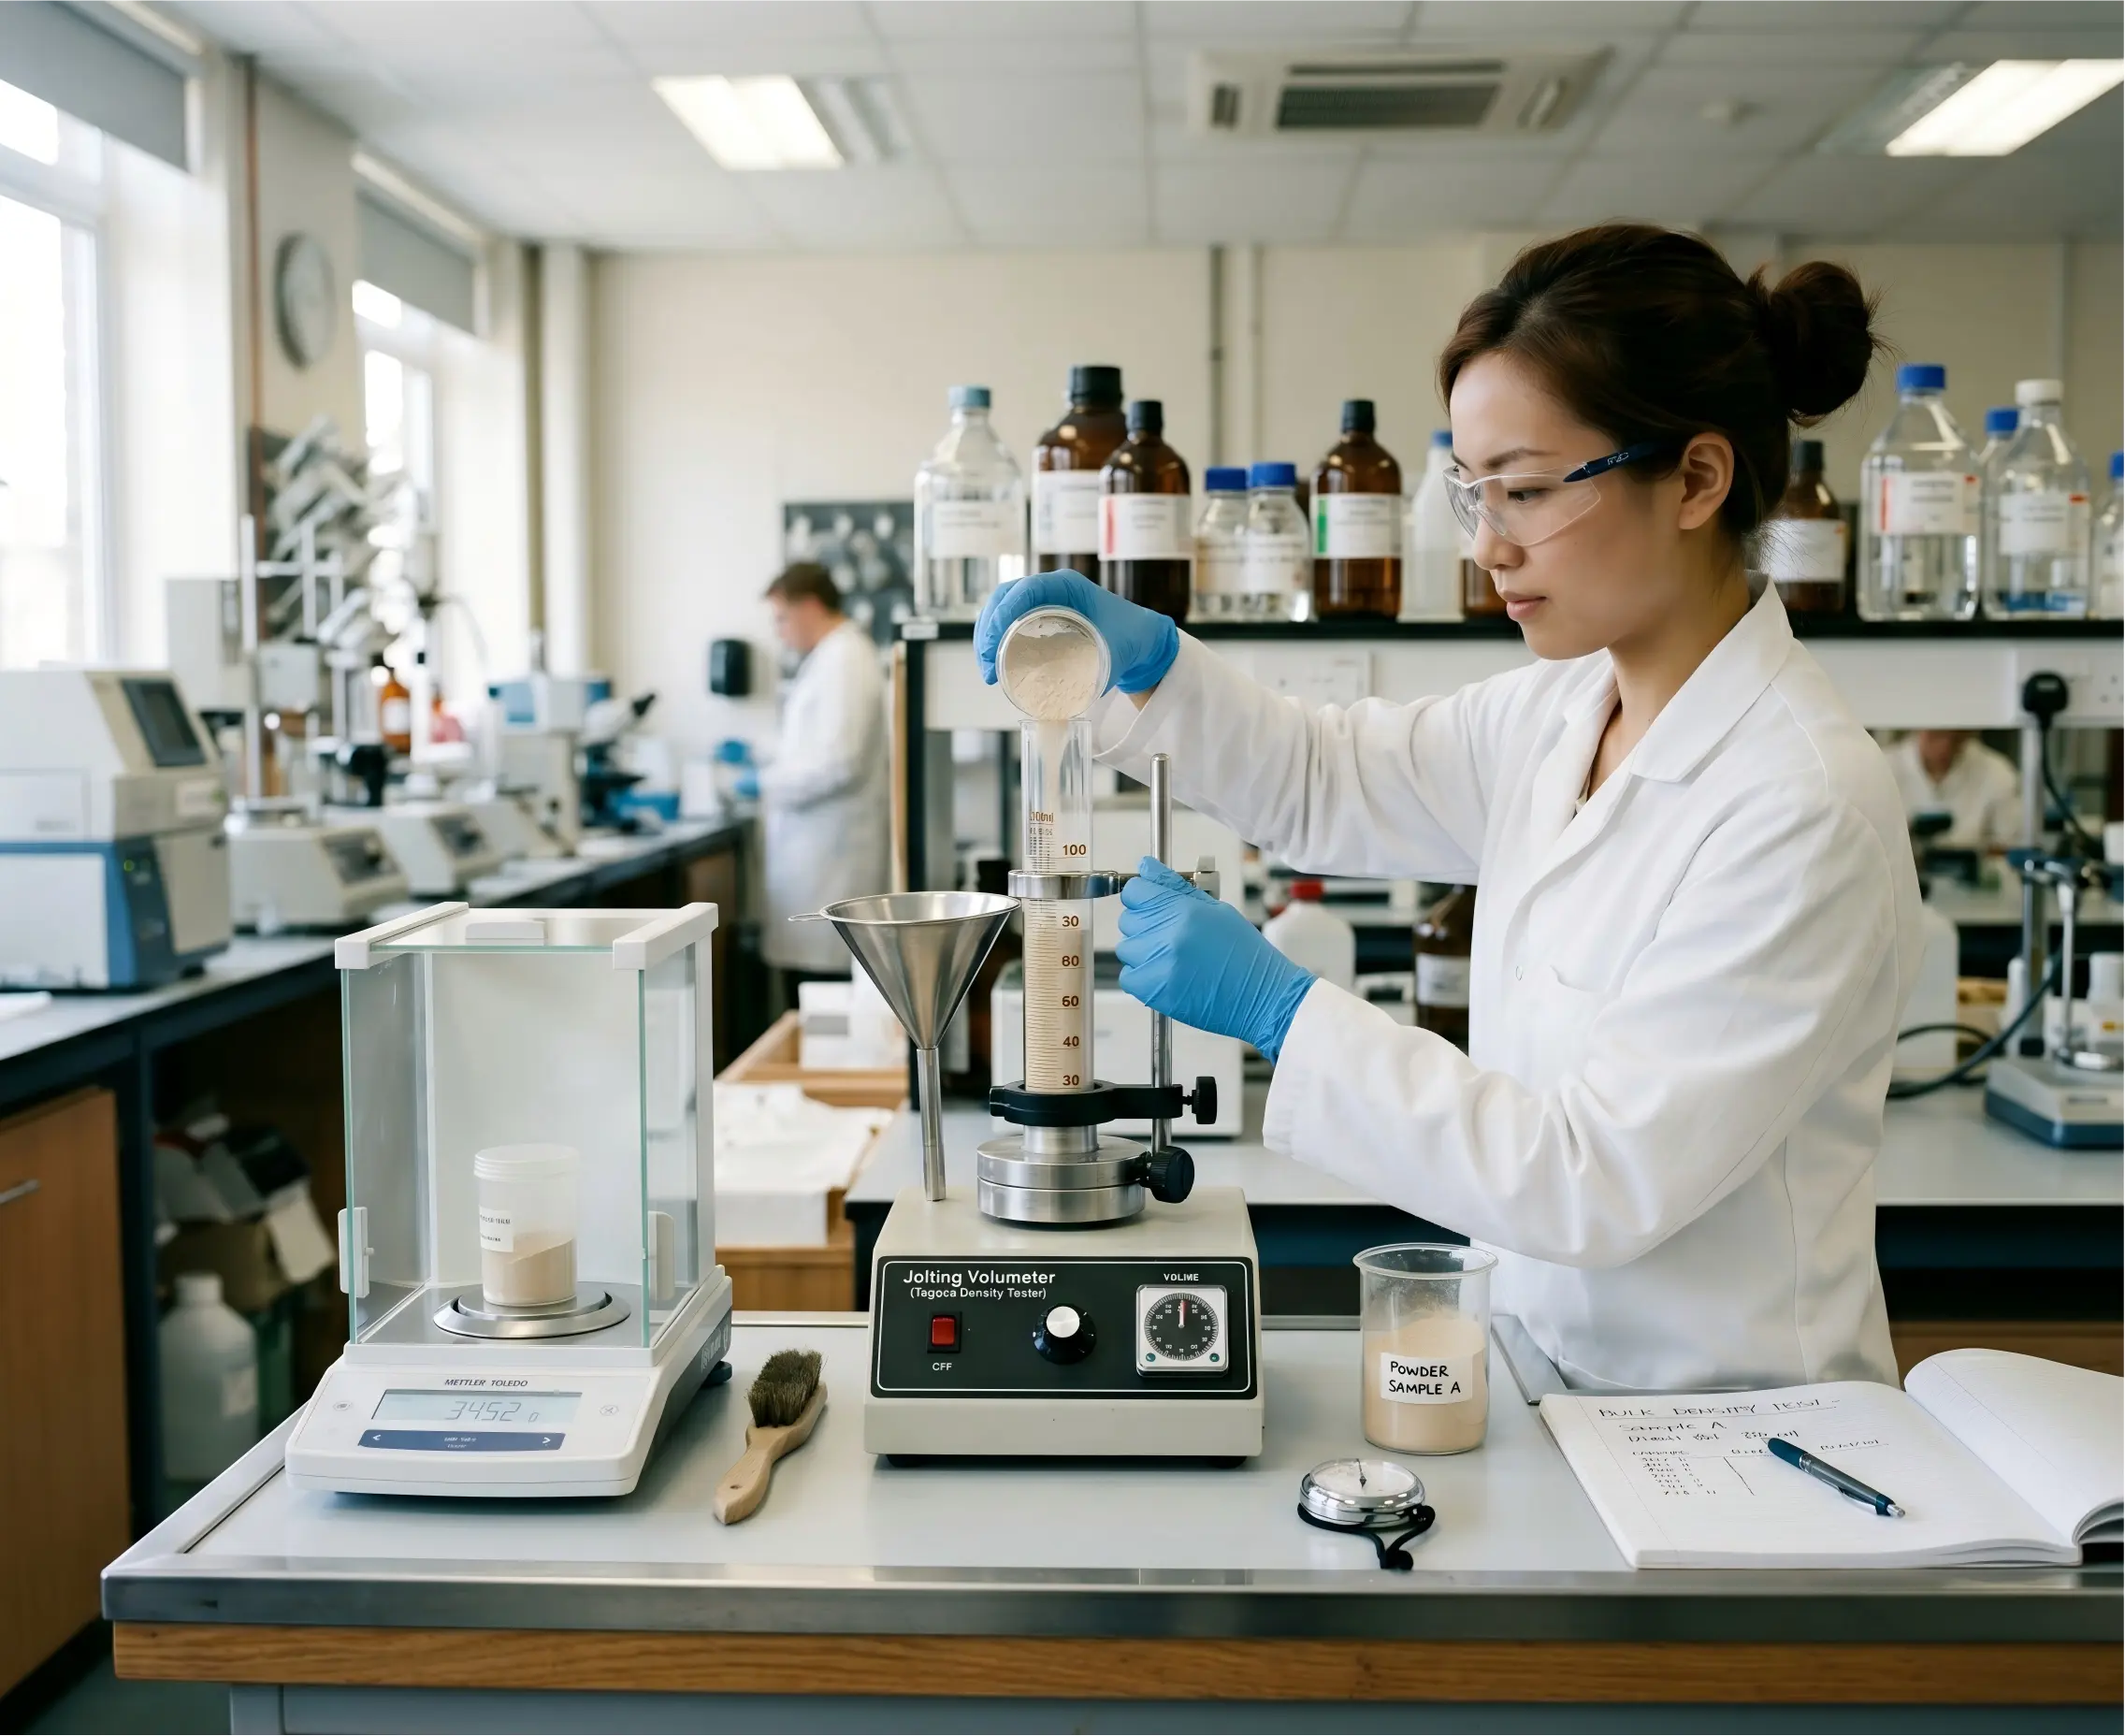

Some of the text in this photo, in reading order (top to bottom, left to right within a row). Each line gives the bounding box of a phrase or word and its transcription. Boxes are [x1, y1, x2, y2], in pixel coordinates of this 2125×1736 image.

[1062, 845, 1087, 856] 100
[1062, 916, 1079, 928] 30
[1062, 995, 1079, 1007] 60
[1062, 1035, 1080, 1048] 40
[1062, 1075, 1080, 1086] 30
[903, 1269, 1056, 1287] Jolting Volumeter
[960, 1287, 1005, 1300] Density
[1007, 1287, 1047, 1300] Tester)
[1390, 1361, 1449, 1378] POWDER
[1389, 1380, 1461, 1396] SAMPLE A
